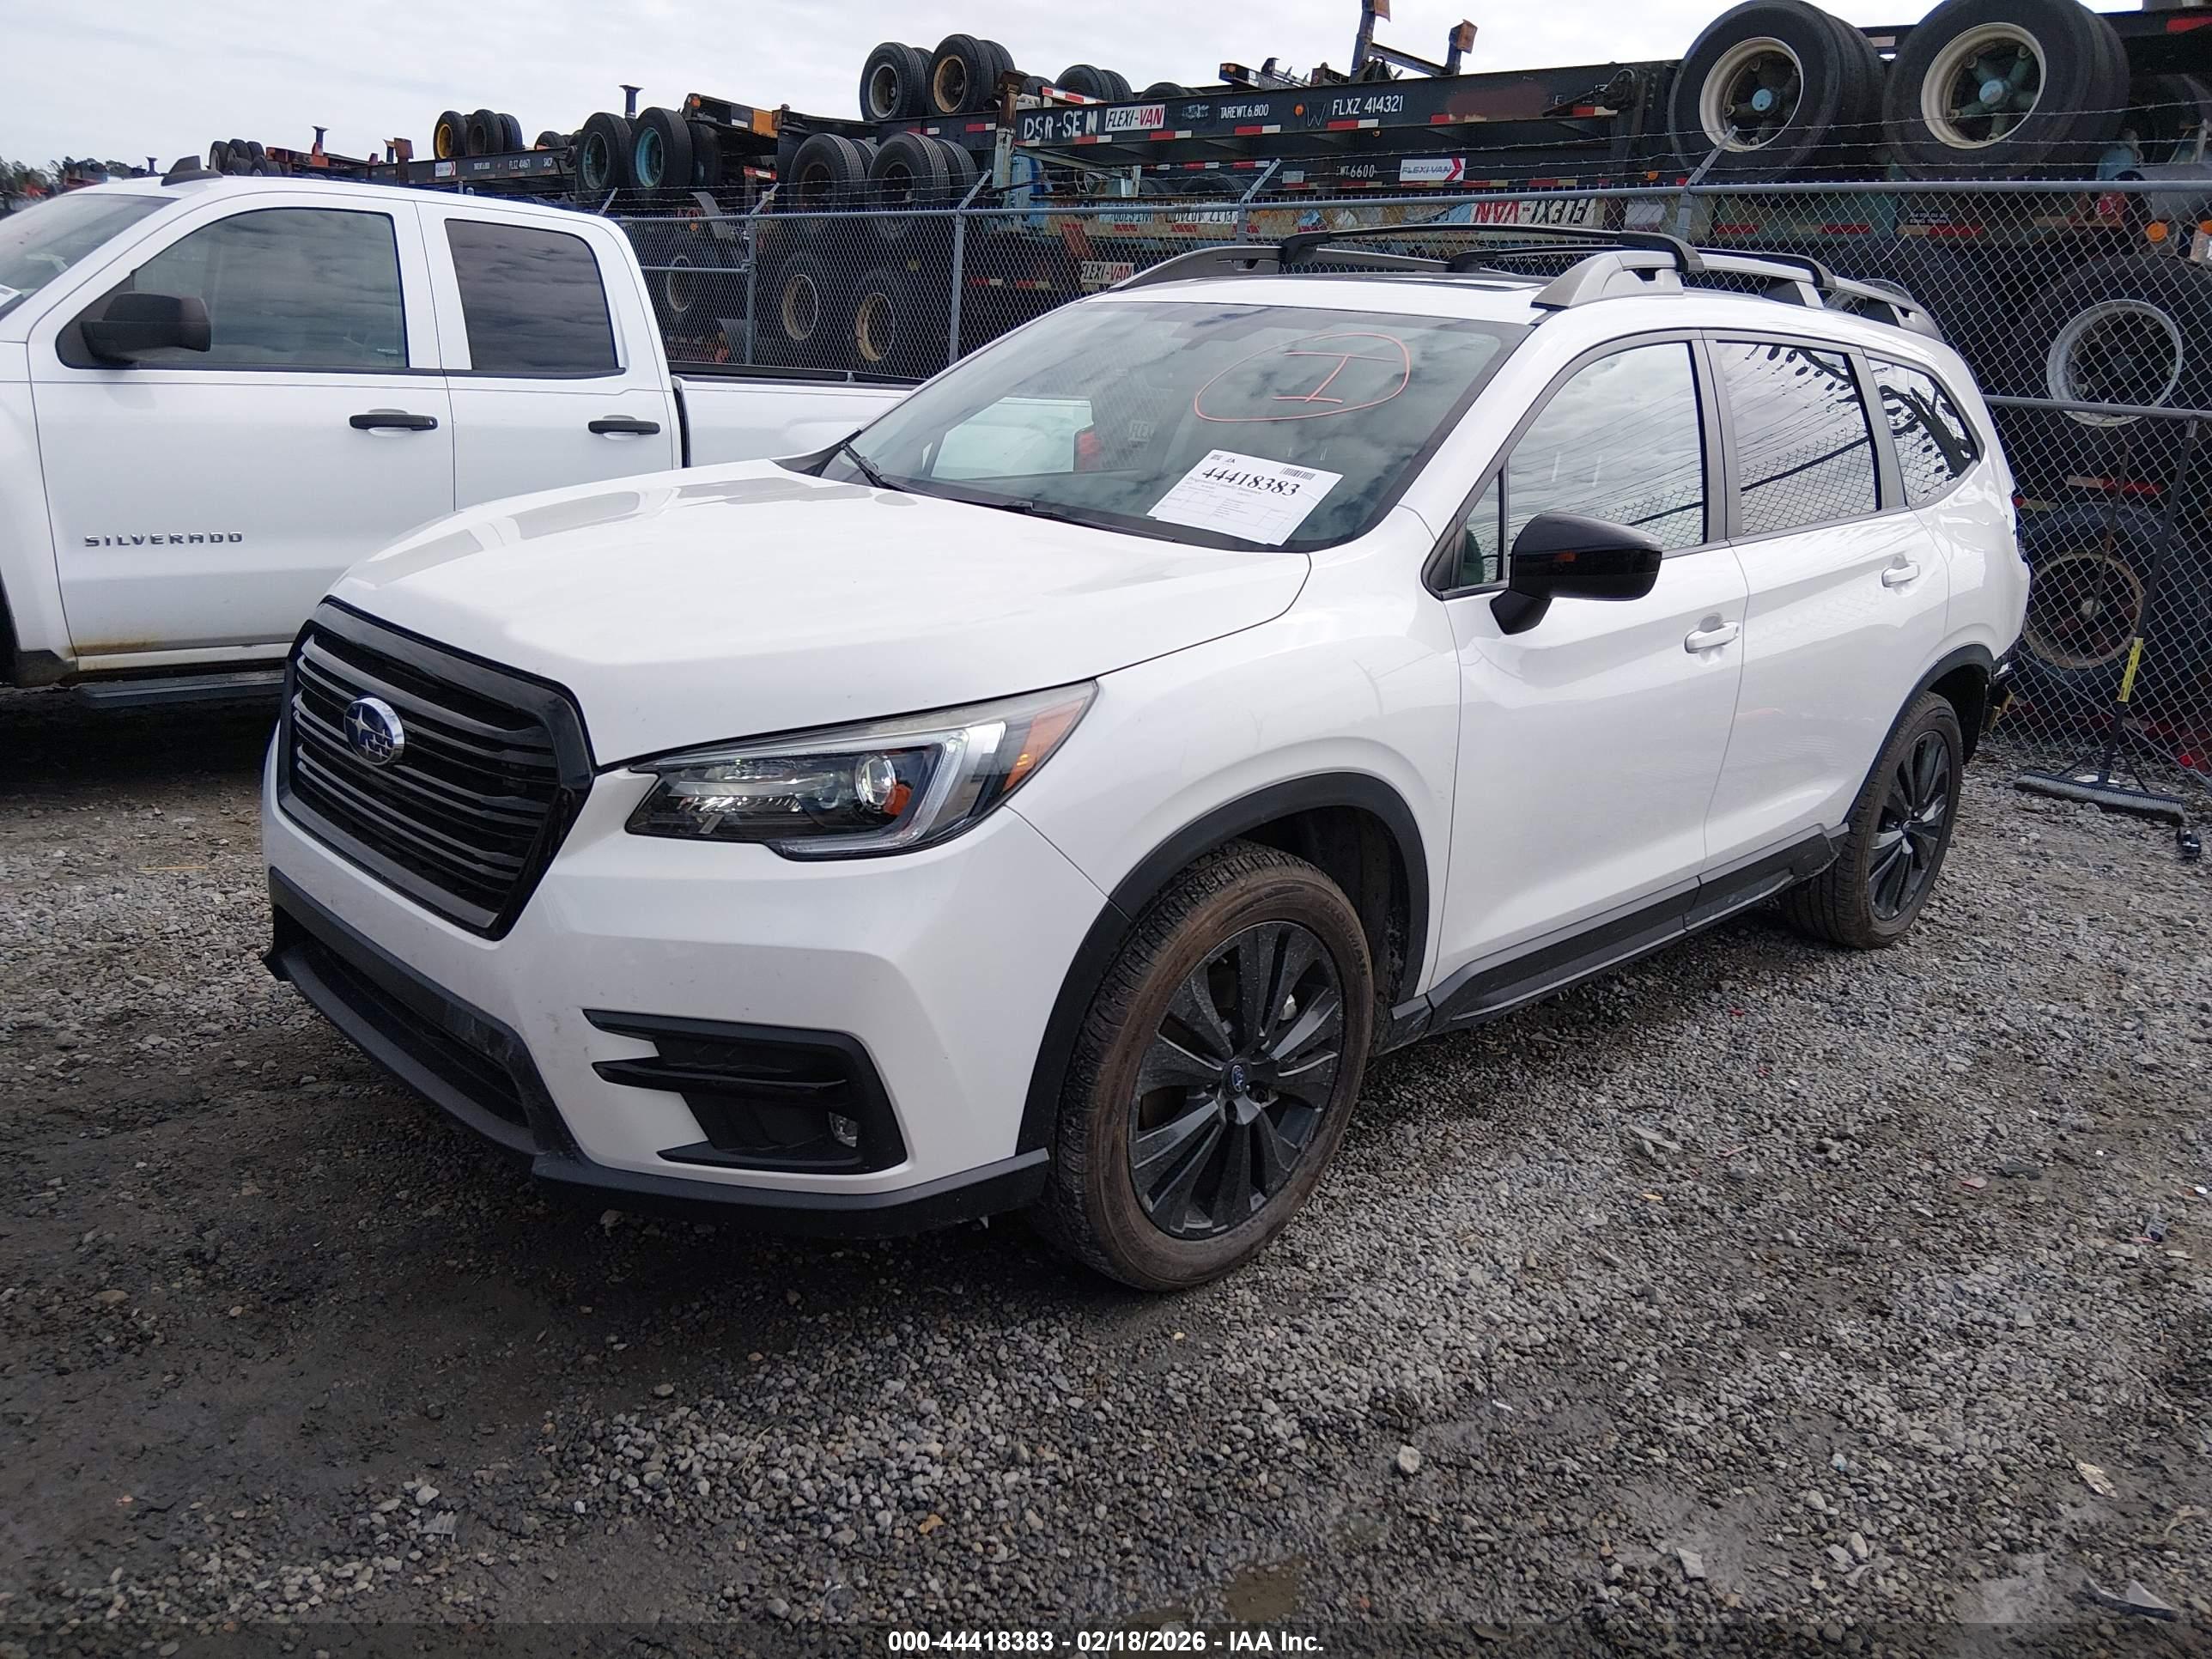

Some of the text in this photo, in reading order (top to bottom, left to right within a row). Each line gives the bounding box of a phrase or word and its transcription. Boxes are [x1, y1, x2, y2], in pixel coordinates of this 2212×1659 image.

[1332, 95, 1404, 116] FLXZ 414321
[1106, 108, 1164, 128] FLEXI-VAN
[1350, 164, 1375, 179] 6600
[1202, 468, 1301, 496] 44418383
[85, 532, 243, 547] SILVERADO
